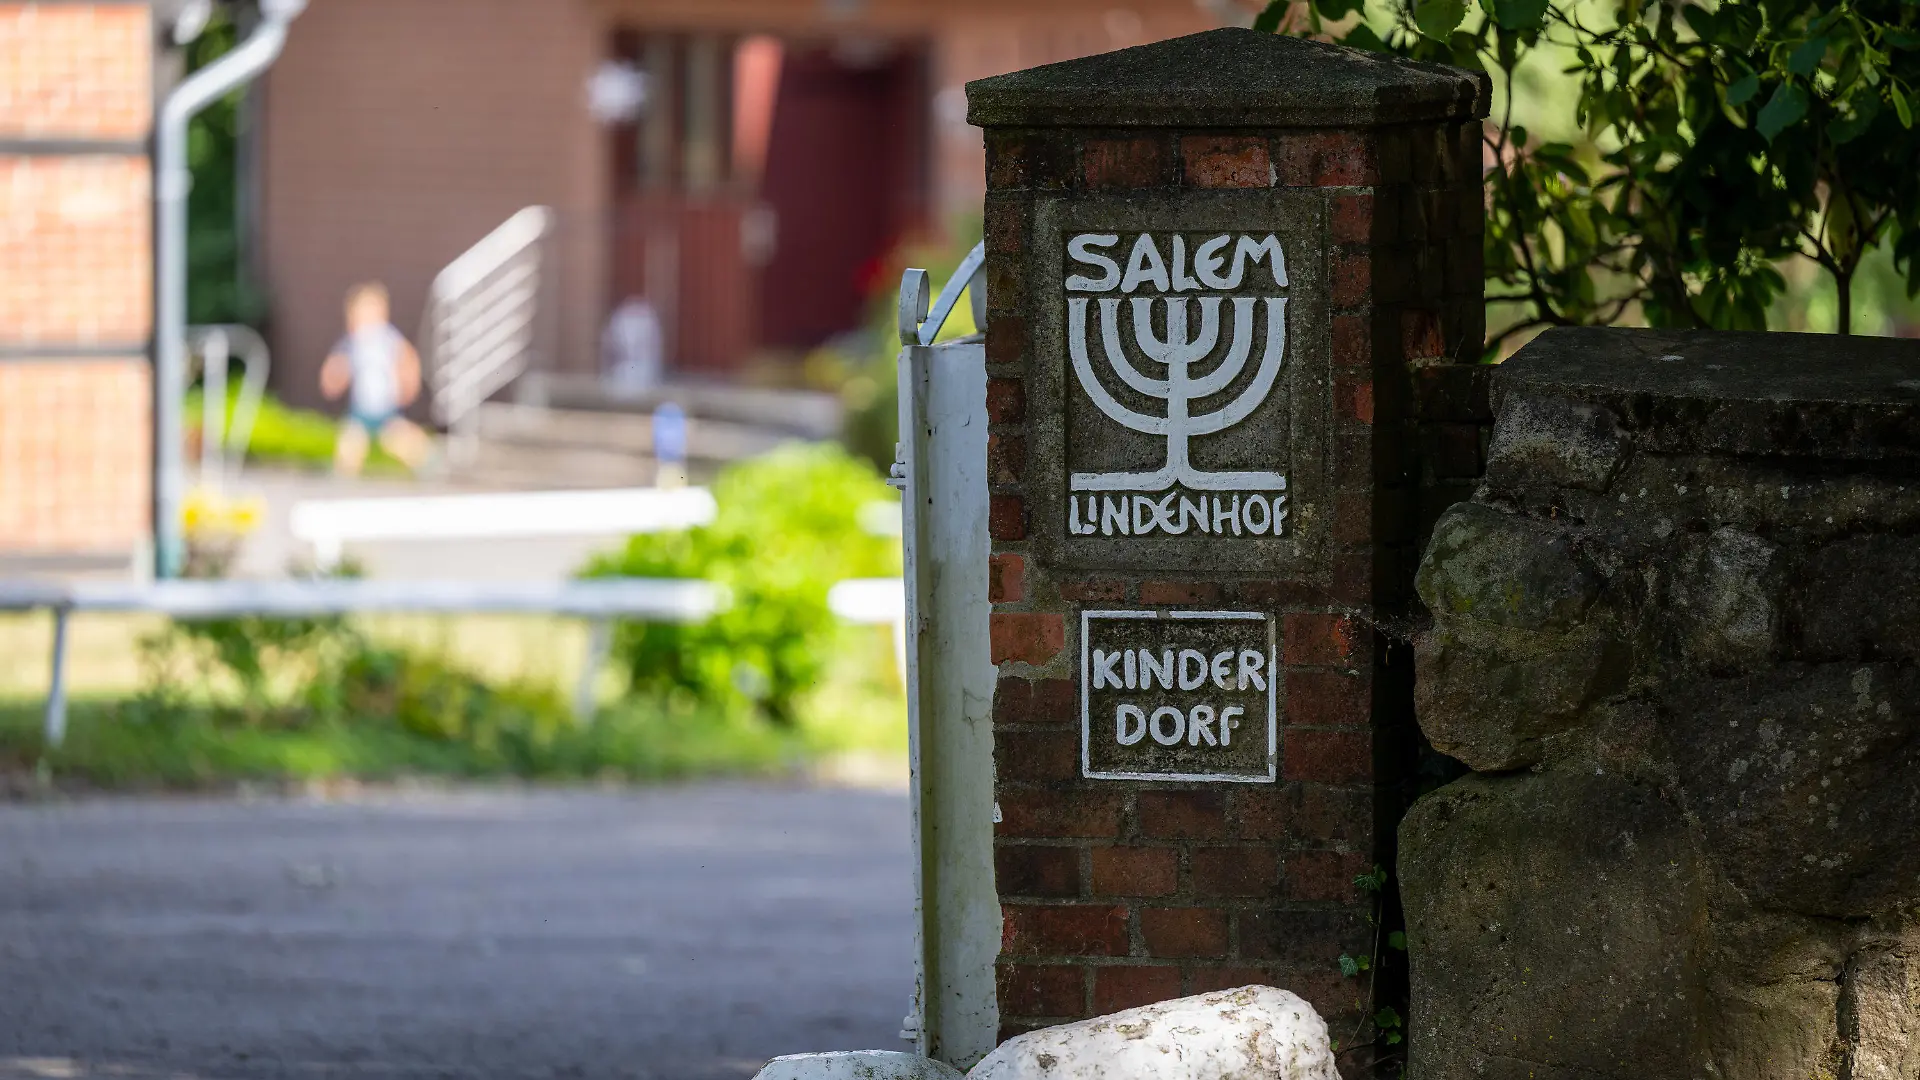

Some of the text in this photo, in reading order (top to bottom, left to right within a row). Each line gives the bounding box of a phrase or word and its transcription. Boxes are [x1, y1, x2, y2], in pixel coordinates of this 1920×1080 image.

[1065, 233, 1288, 293] SALEM
[1069, 491, 1288, 536] LINDENHOF
[1093, 649, 1266, 691] KINDER
[1116, 704, 1244, 746] DORF
